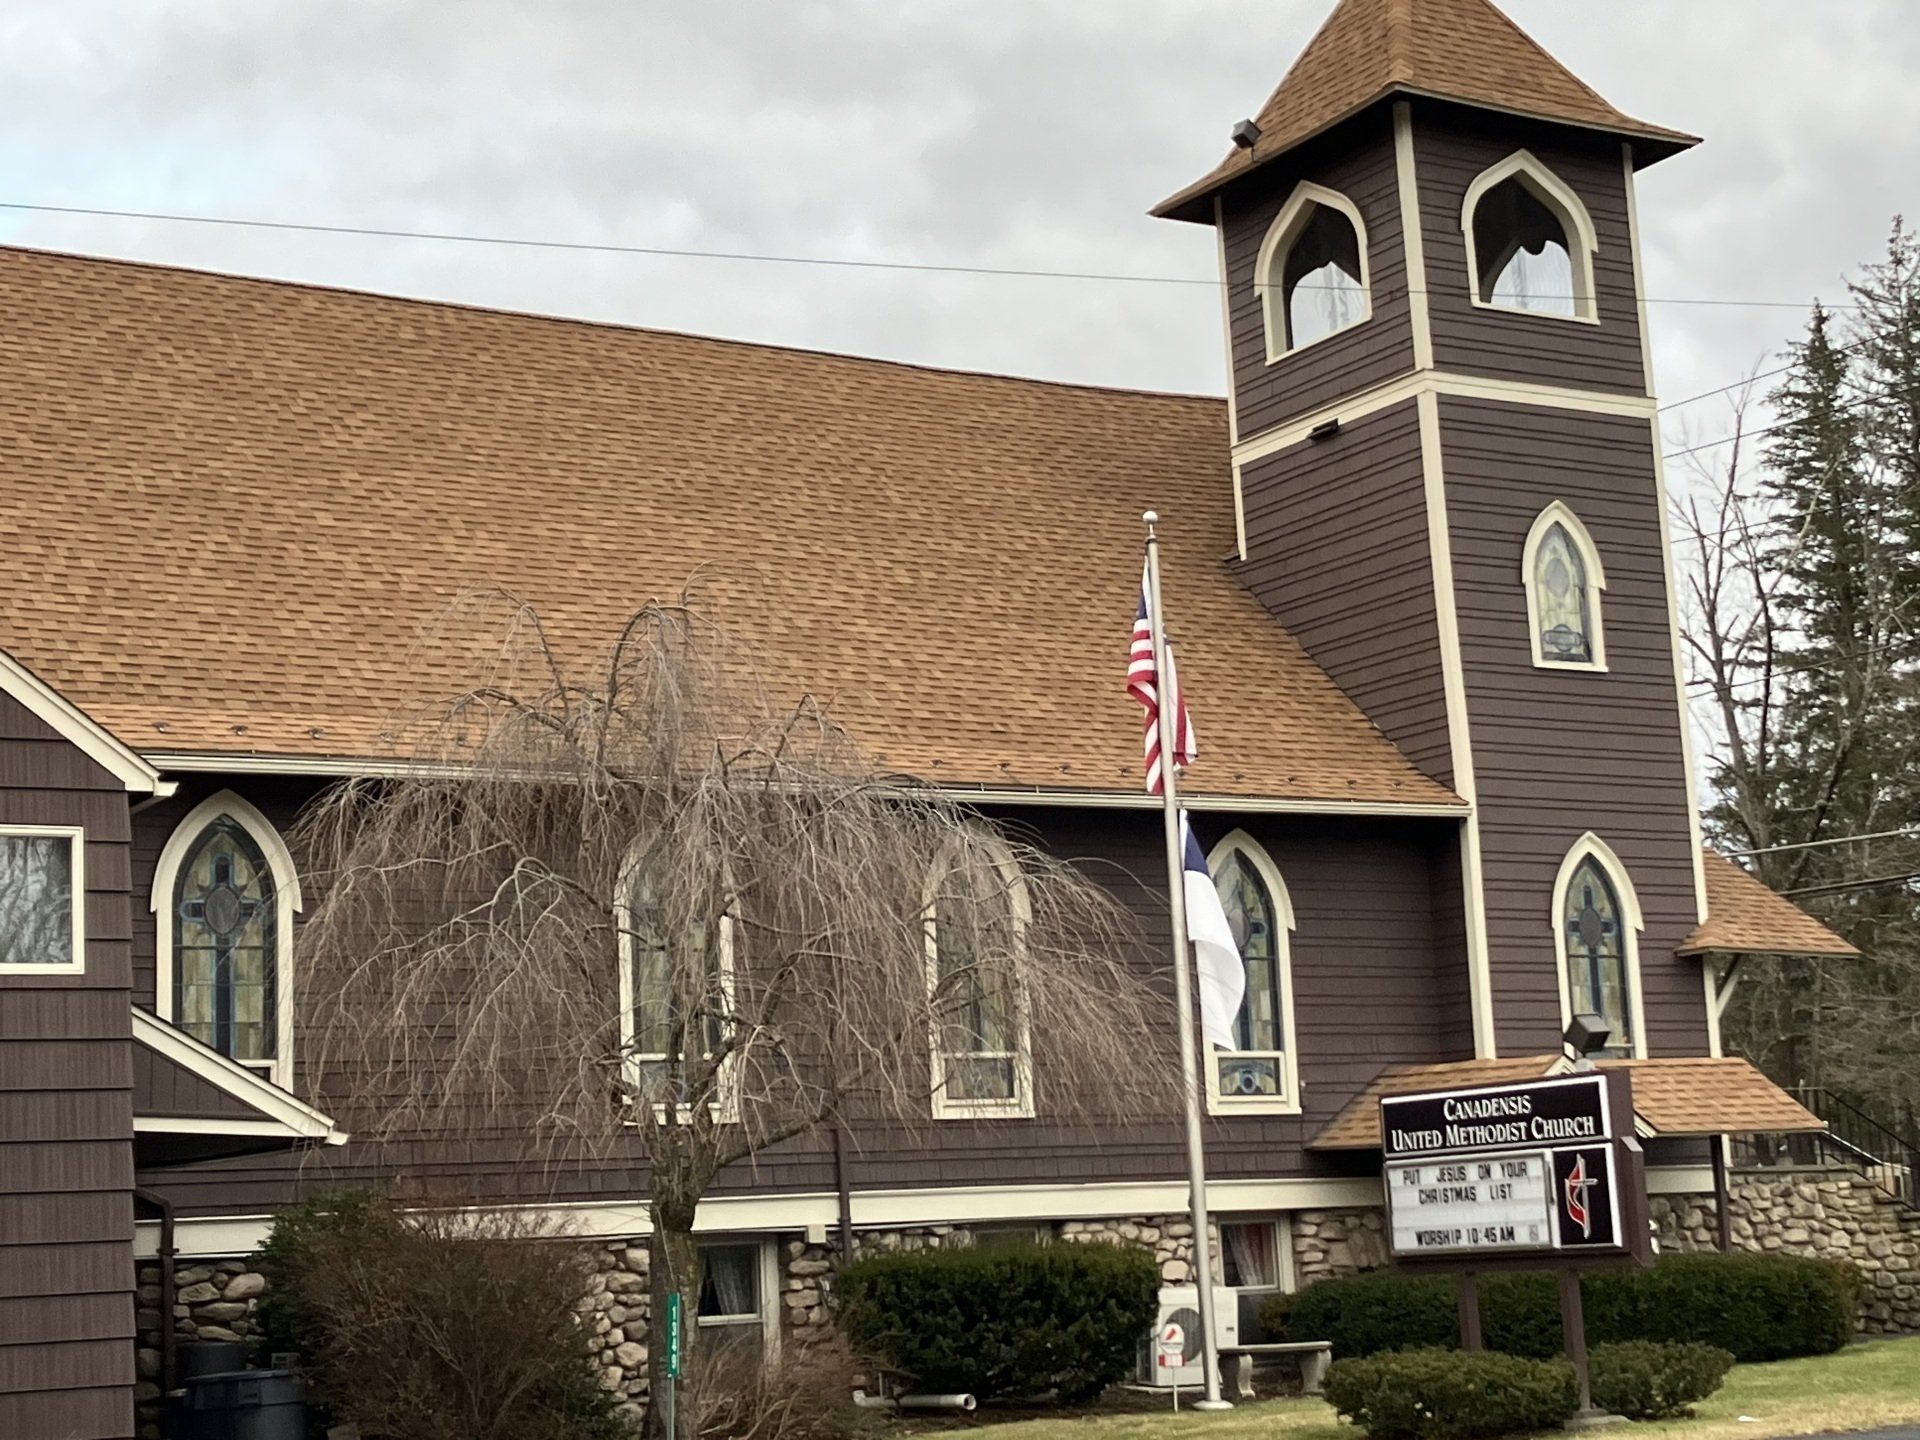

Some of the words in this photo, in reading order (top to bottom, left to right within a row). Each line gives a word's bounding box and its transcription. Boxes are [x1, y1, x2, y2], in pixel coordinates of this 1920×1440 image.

[1443, 1095, 1531, 1120] CANADENSIS
[1392, 1129, 1442, 1151] UNITED
[1445, 1121, 1527, 1145] METHODIST
[1531, 1116, 1595, 1139] CHURCH
[1403, 1170, 1420, 1185] PUT
[1436, 1166, 1466, 1183] JESUS
[1478, 1164, 1491, 1180] ON
[1500, 1162, 1527, 1178] YOUR
[1419, 1186, 1477, 1204] CHRISTMAS
[1490, 1184, 1513, 1200] LIST
[1415, 1229, 1461, 1246] WORSHIP
[1467, 1227, 1497, 1243] 10:45
[1500, 1226, 1515, 1241] AM
